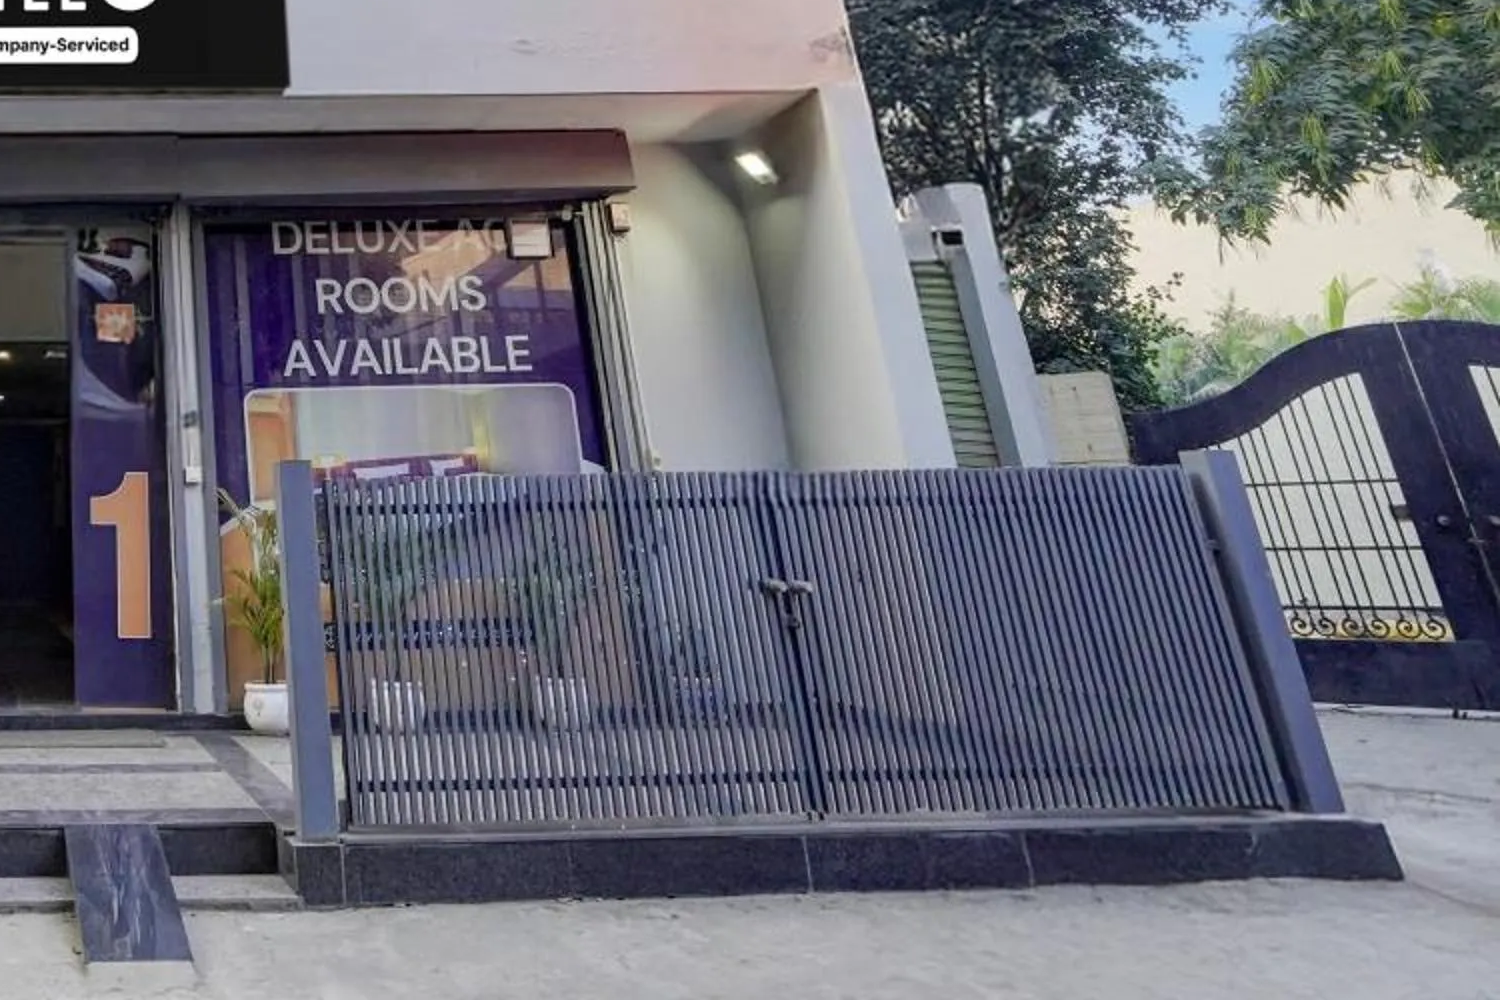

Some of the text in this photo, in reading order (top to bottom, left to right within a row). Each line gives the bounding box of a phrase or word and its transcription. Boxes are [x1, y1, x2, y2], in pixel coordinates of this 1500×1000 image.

[271, 218, 440, 256] DELUXE
[315, 275, 487, 315] ROOMS
[283, 334, 533, 378] AVAILABLE
